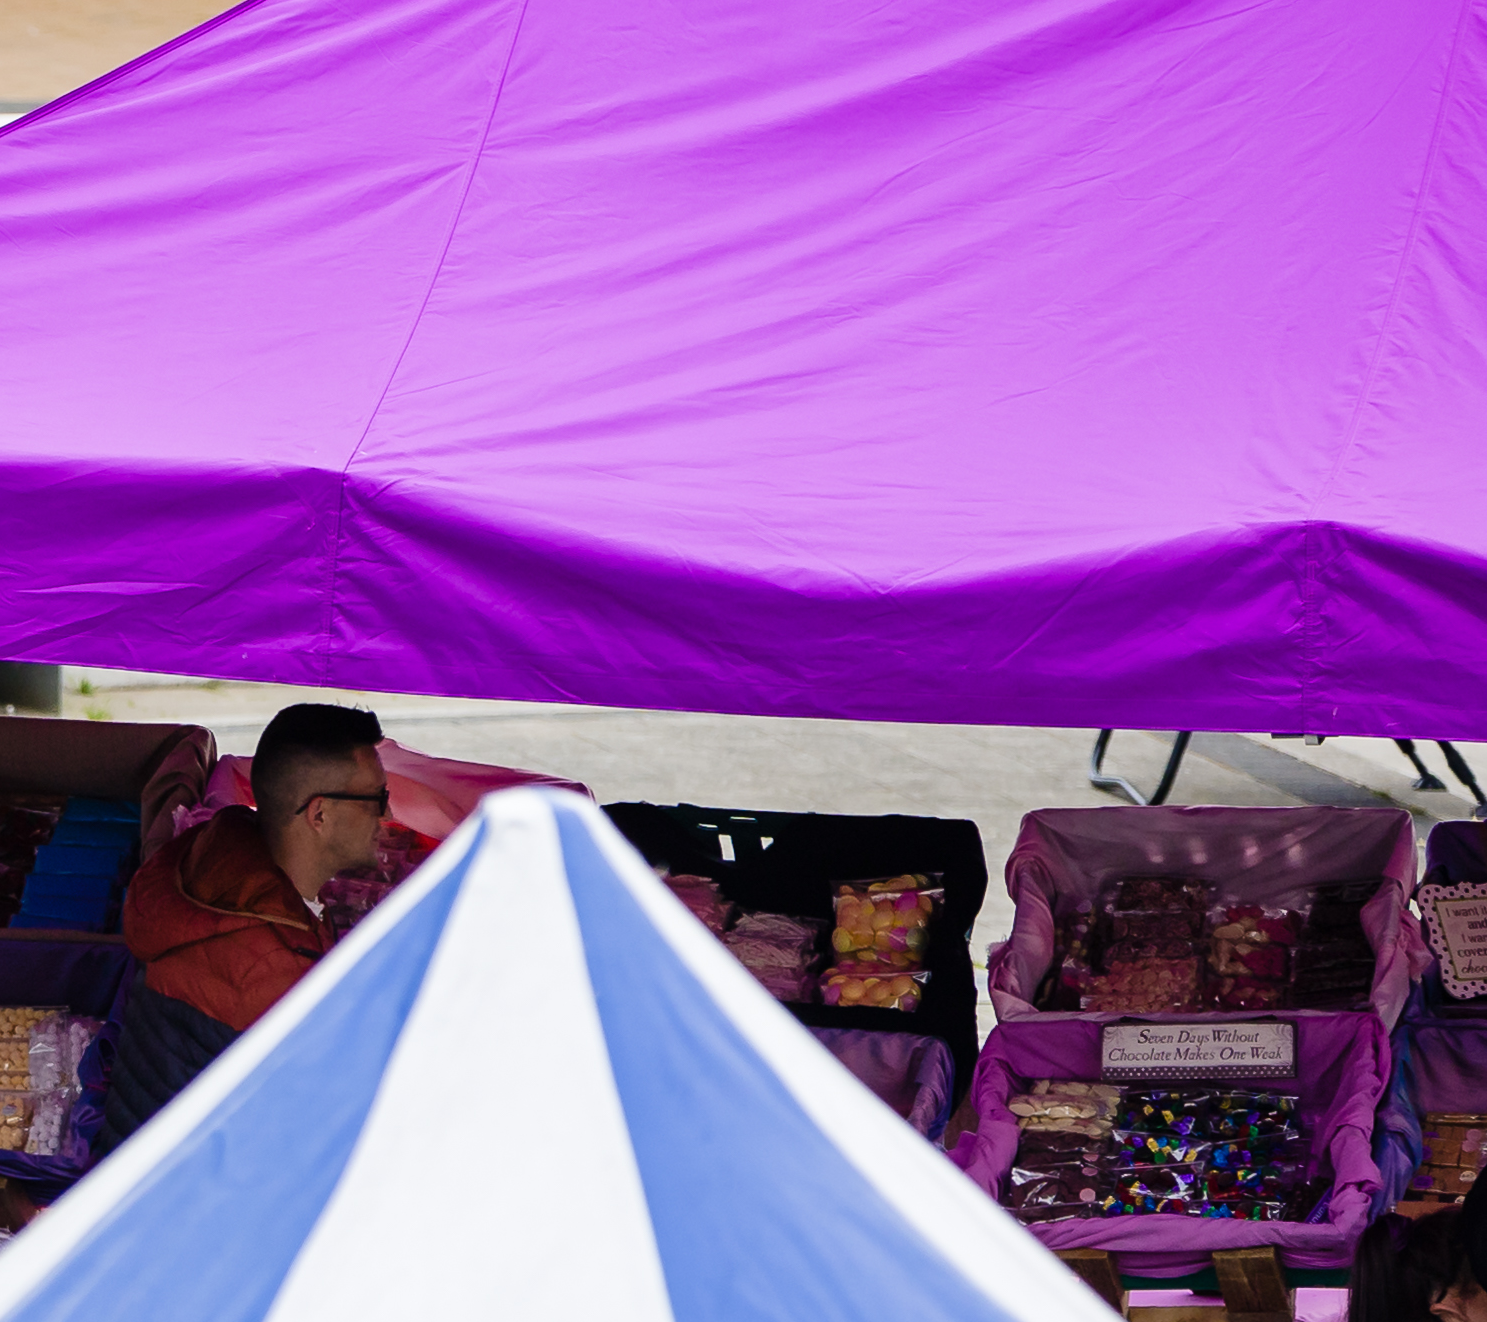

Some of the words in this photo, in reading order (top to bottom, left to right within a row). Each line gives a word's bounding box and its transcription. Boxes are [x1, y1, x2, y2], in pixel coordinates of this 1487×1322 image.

[1452, 907, 1478, 917] want
[1138, 1029, 1174, 1044] Seven
[1177, 1030, 1210, 1047] Days
[1212, 1029, 1260, 1043] Without
[1108, 1048, 1171, 1062] Chocolate
[1174, 1046, 1215, 1061] Makes
[1220, 1046, 1247, 1060] One
[1250, 1046, 1283, 1060] Weak
